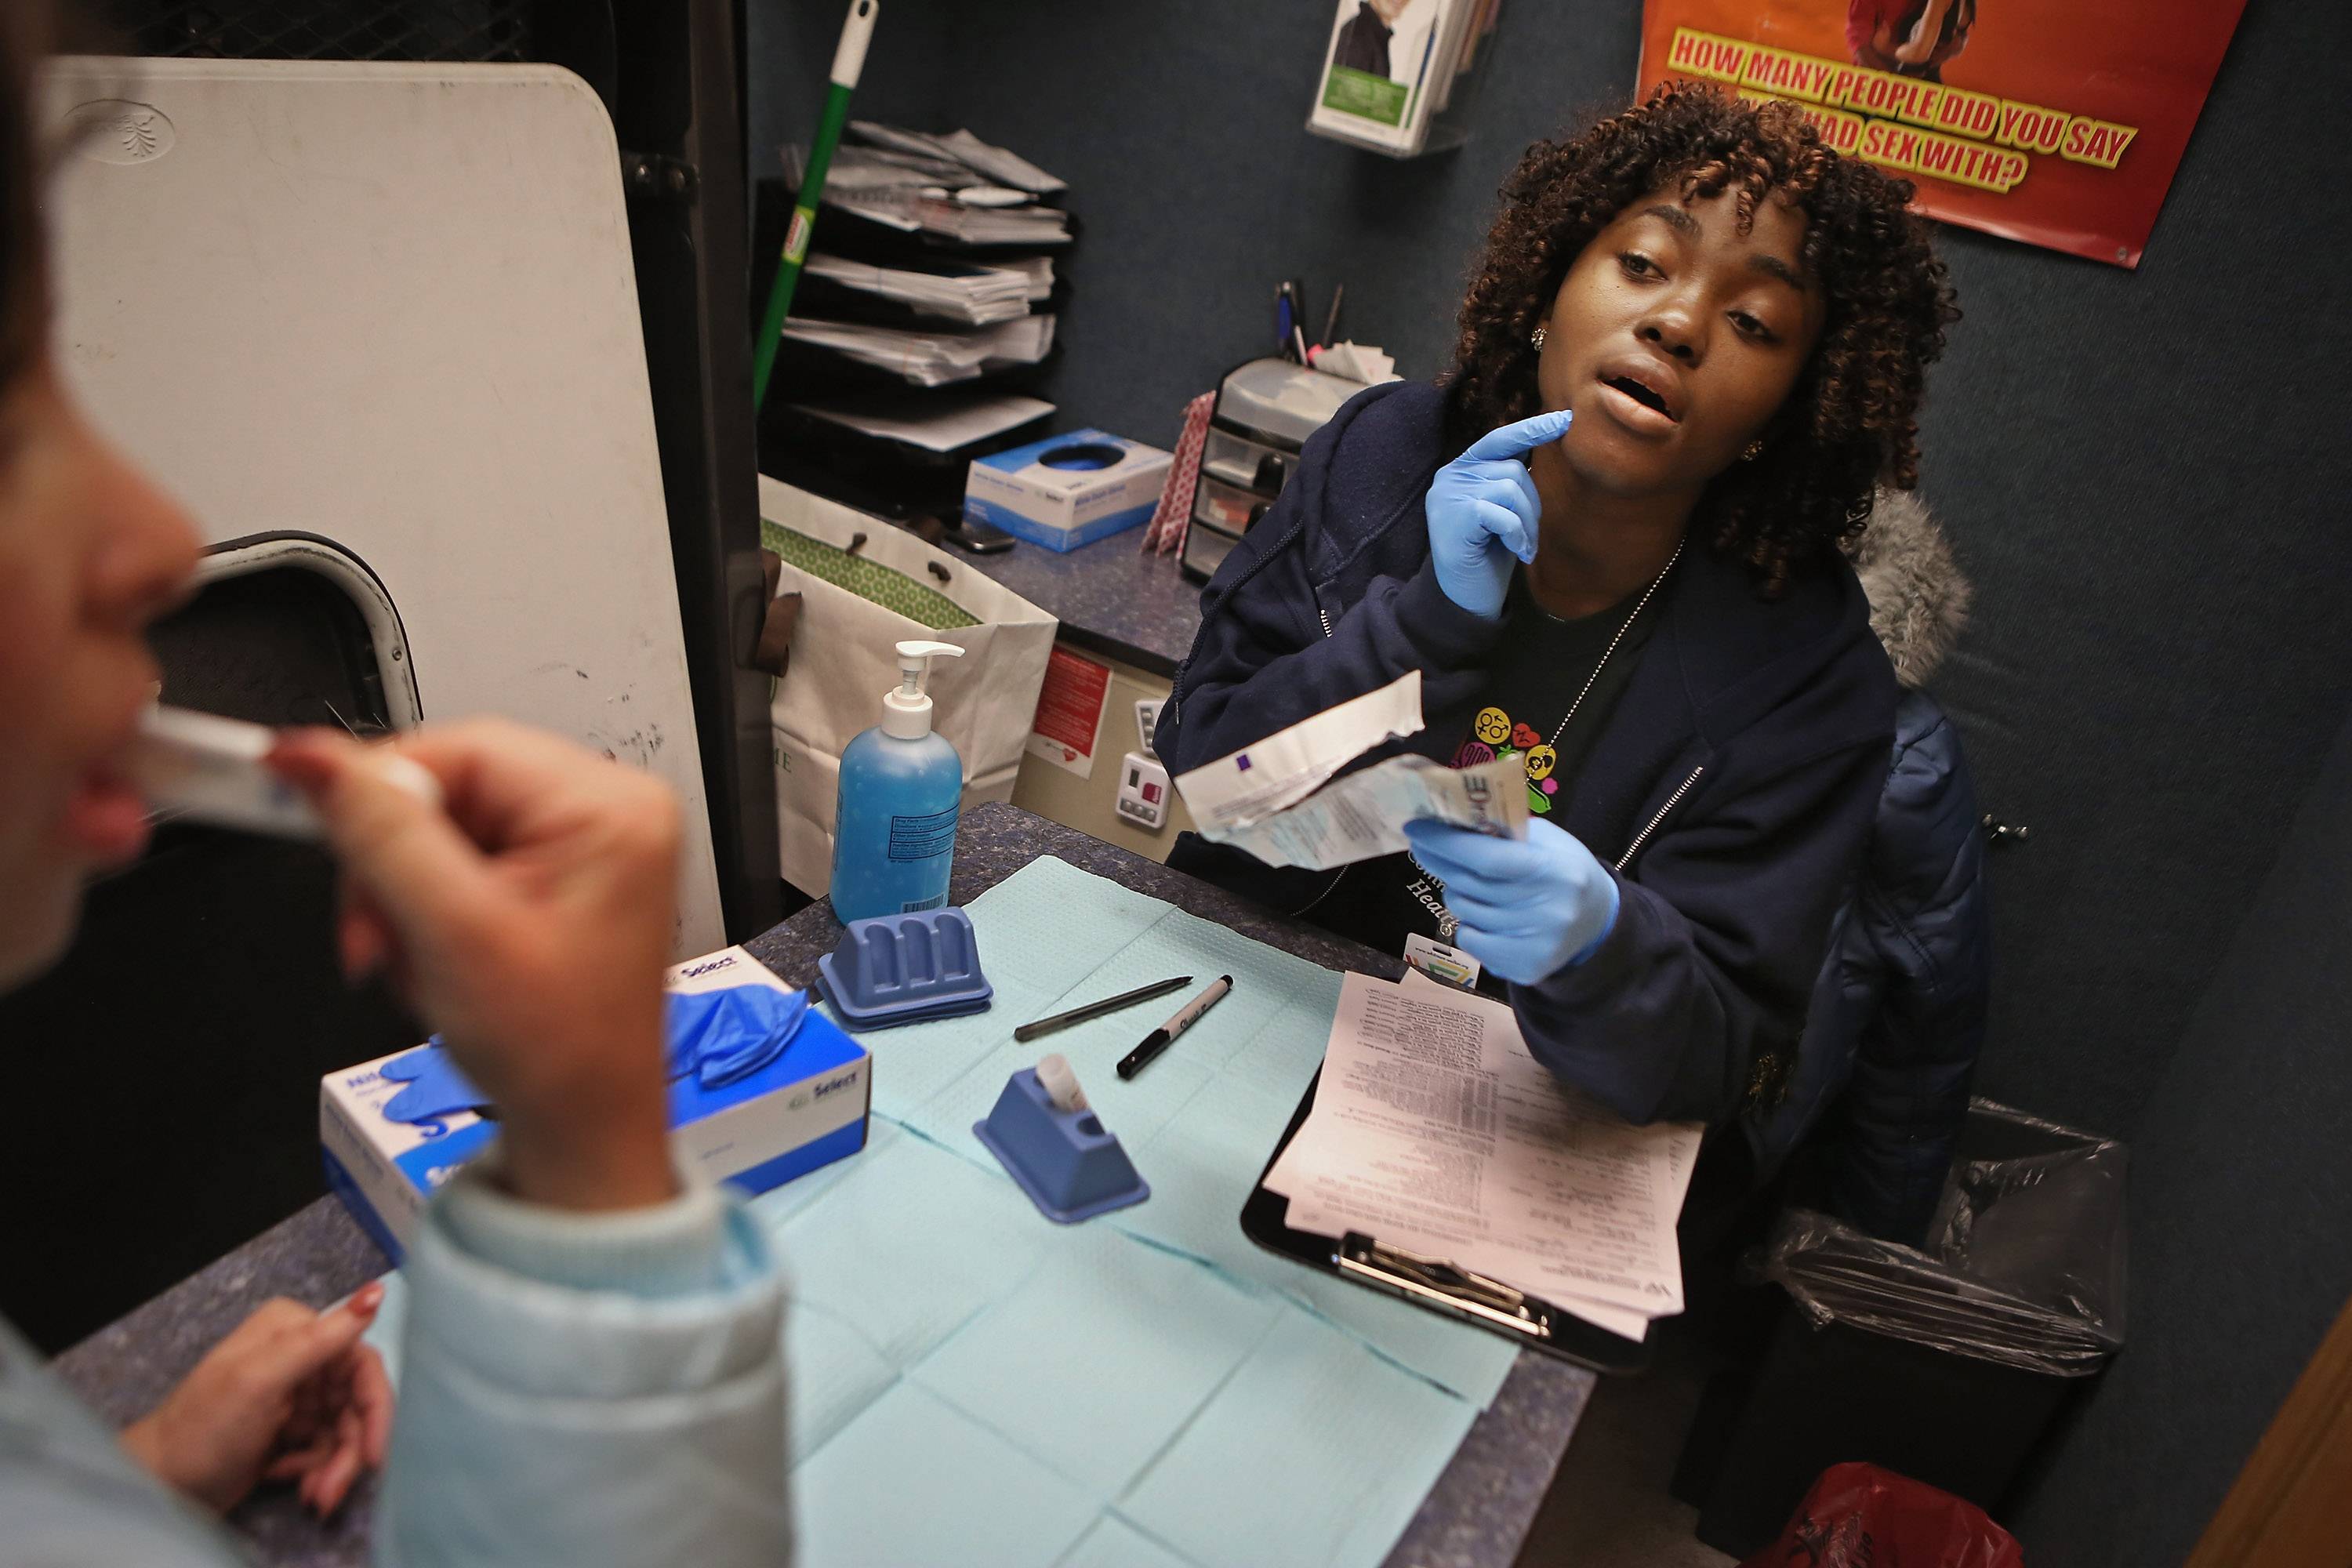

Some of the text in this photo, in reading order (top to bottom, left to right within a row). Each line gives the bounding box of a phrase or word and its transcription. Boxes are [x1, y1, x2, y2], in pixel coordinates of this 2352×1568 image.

[1674, 34, 2130, 164] HOW MANY PEOPLE DID YOU SAY
[1864, 124, 1918, 165] SEX
[1921, 136, 2024, 187] WITH?
[1406, 878, 1460, 927] Heal
[681, 956, 738, 978] Select
